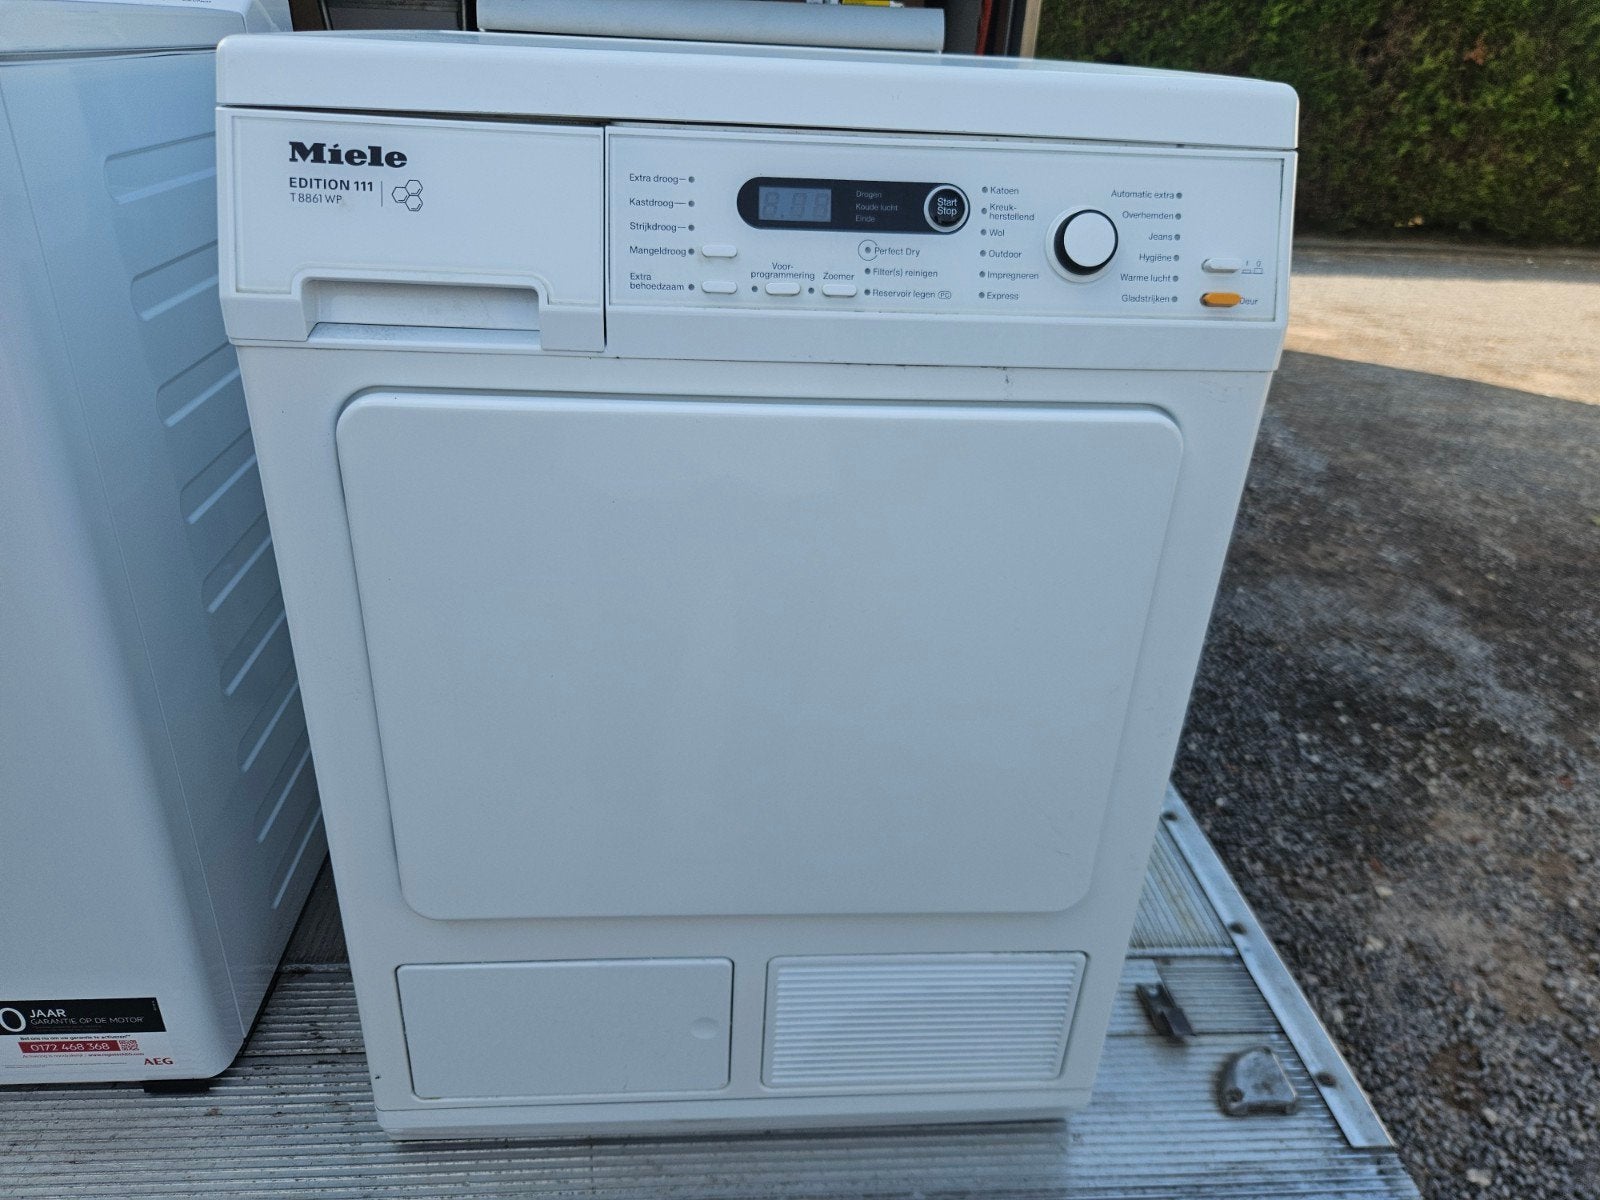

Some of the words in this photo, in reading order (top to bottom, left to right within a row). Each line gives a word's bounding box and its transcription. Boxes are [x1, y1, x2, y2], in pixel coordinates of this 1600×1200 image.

[289, 142, 408, 168] Miele
[629, 173, 651, 182] Extra
[653, 174, 679, 185] droog
[289, 177, 350, 190] EDITION
[354, 181, 373, 192] 111
[856, 190, 882, 199] Drogen
[990, 186, 1019, 194] Katoen
[1111, 190, 1152, 199] Automatic
[325, 194, 342, 204] WP
[629, 198, 674, 209] Kastdroog
[937, 198, 957, 206] Start
[856, 203, 879, 211] Koude
[937, 206, 958, 217] Stop
[990, 203, 1017, 211] Kreuk-
[856, 214, 875, 223] Einde
[989, 213, 1035, 221] herstellend
[1122, 211, 1174, 220] Overhemden
[629, 222, 677, 233] Strijkdroog
[990, 229, 1005, 237] Wol
[1148, 233, 1173, 241] Jeans
[629, 246, 687, 257] Mangeldroog
[874, 246, 903, 256] Perfect
[905, 248, 920, 257] Dry
[988, 250, 1022, 258] Outdoor
[1139, 254, 1172, 263] Hygiëne
[772, 262, 794, 271] Voor-
[630, 273, 652, 281] Extra
[750, 270, 815, 281] programmering
[823, 272, 855, 281] Zoemer
[873, 268, 903, 277] Filter(s)
[905, 269, 938, 278] reinigen
[987, 271, 1039, 281] Impregneren
[1120, 274, 1148, 282] Warme
[1151, 274, 1171, 282] lucht
[630, 282, 684, 291] behoedzaam
[872, 289, 912, 298] Reservoir
[913, 290, 936, 299] legen
[986, 292, 1019, 300] Express
[1122, 294, 1170, 304] Gladstrijken
[1240, 296, 1258, 305] Deur
[30, 1009, 67, 1018] JAAR
[62, 1043, 84, 1051] 468
[87, 1042, 110, 1050] 368
[144, 1057, 173, 1065] AEG
